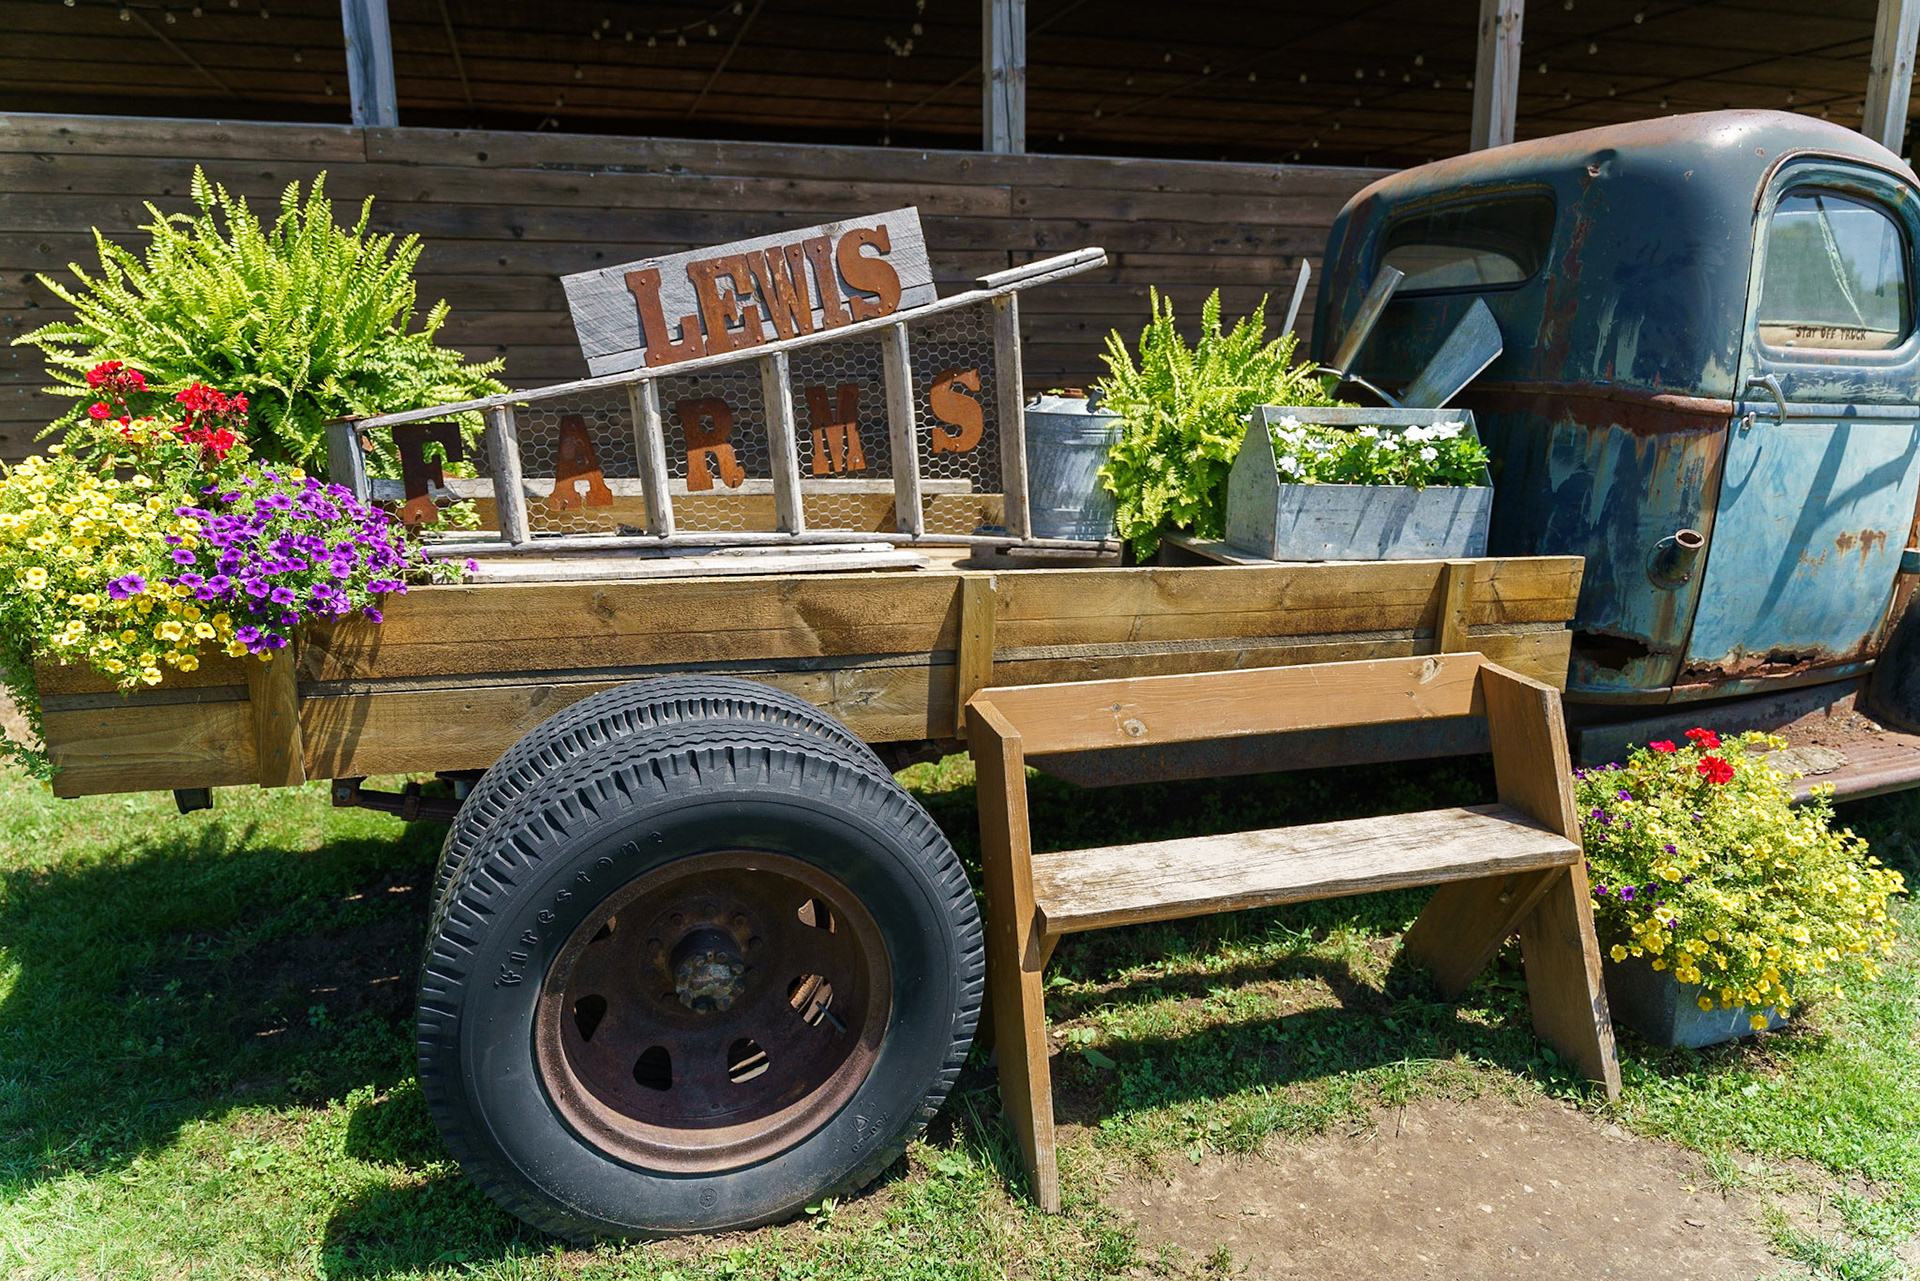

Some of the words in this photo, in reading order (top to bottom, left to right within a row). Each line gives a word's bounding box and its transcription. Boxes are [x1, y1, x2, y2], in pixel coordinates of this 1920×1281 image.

[624, 225, 901, 367] LEWIS
[1820, 327, 1837, 340] OFF
[1840, 329, 1867, 341] TRUCK
[392, 368, 983, 525] FARMS
